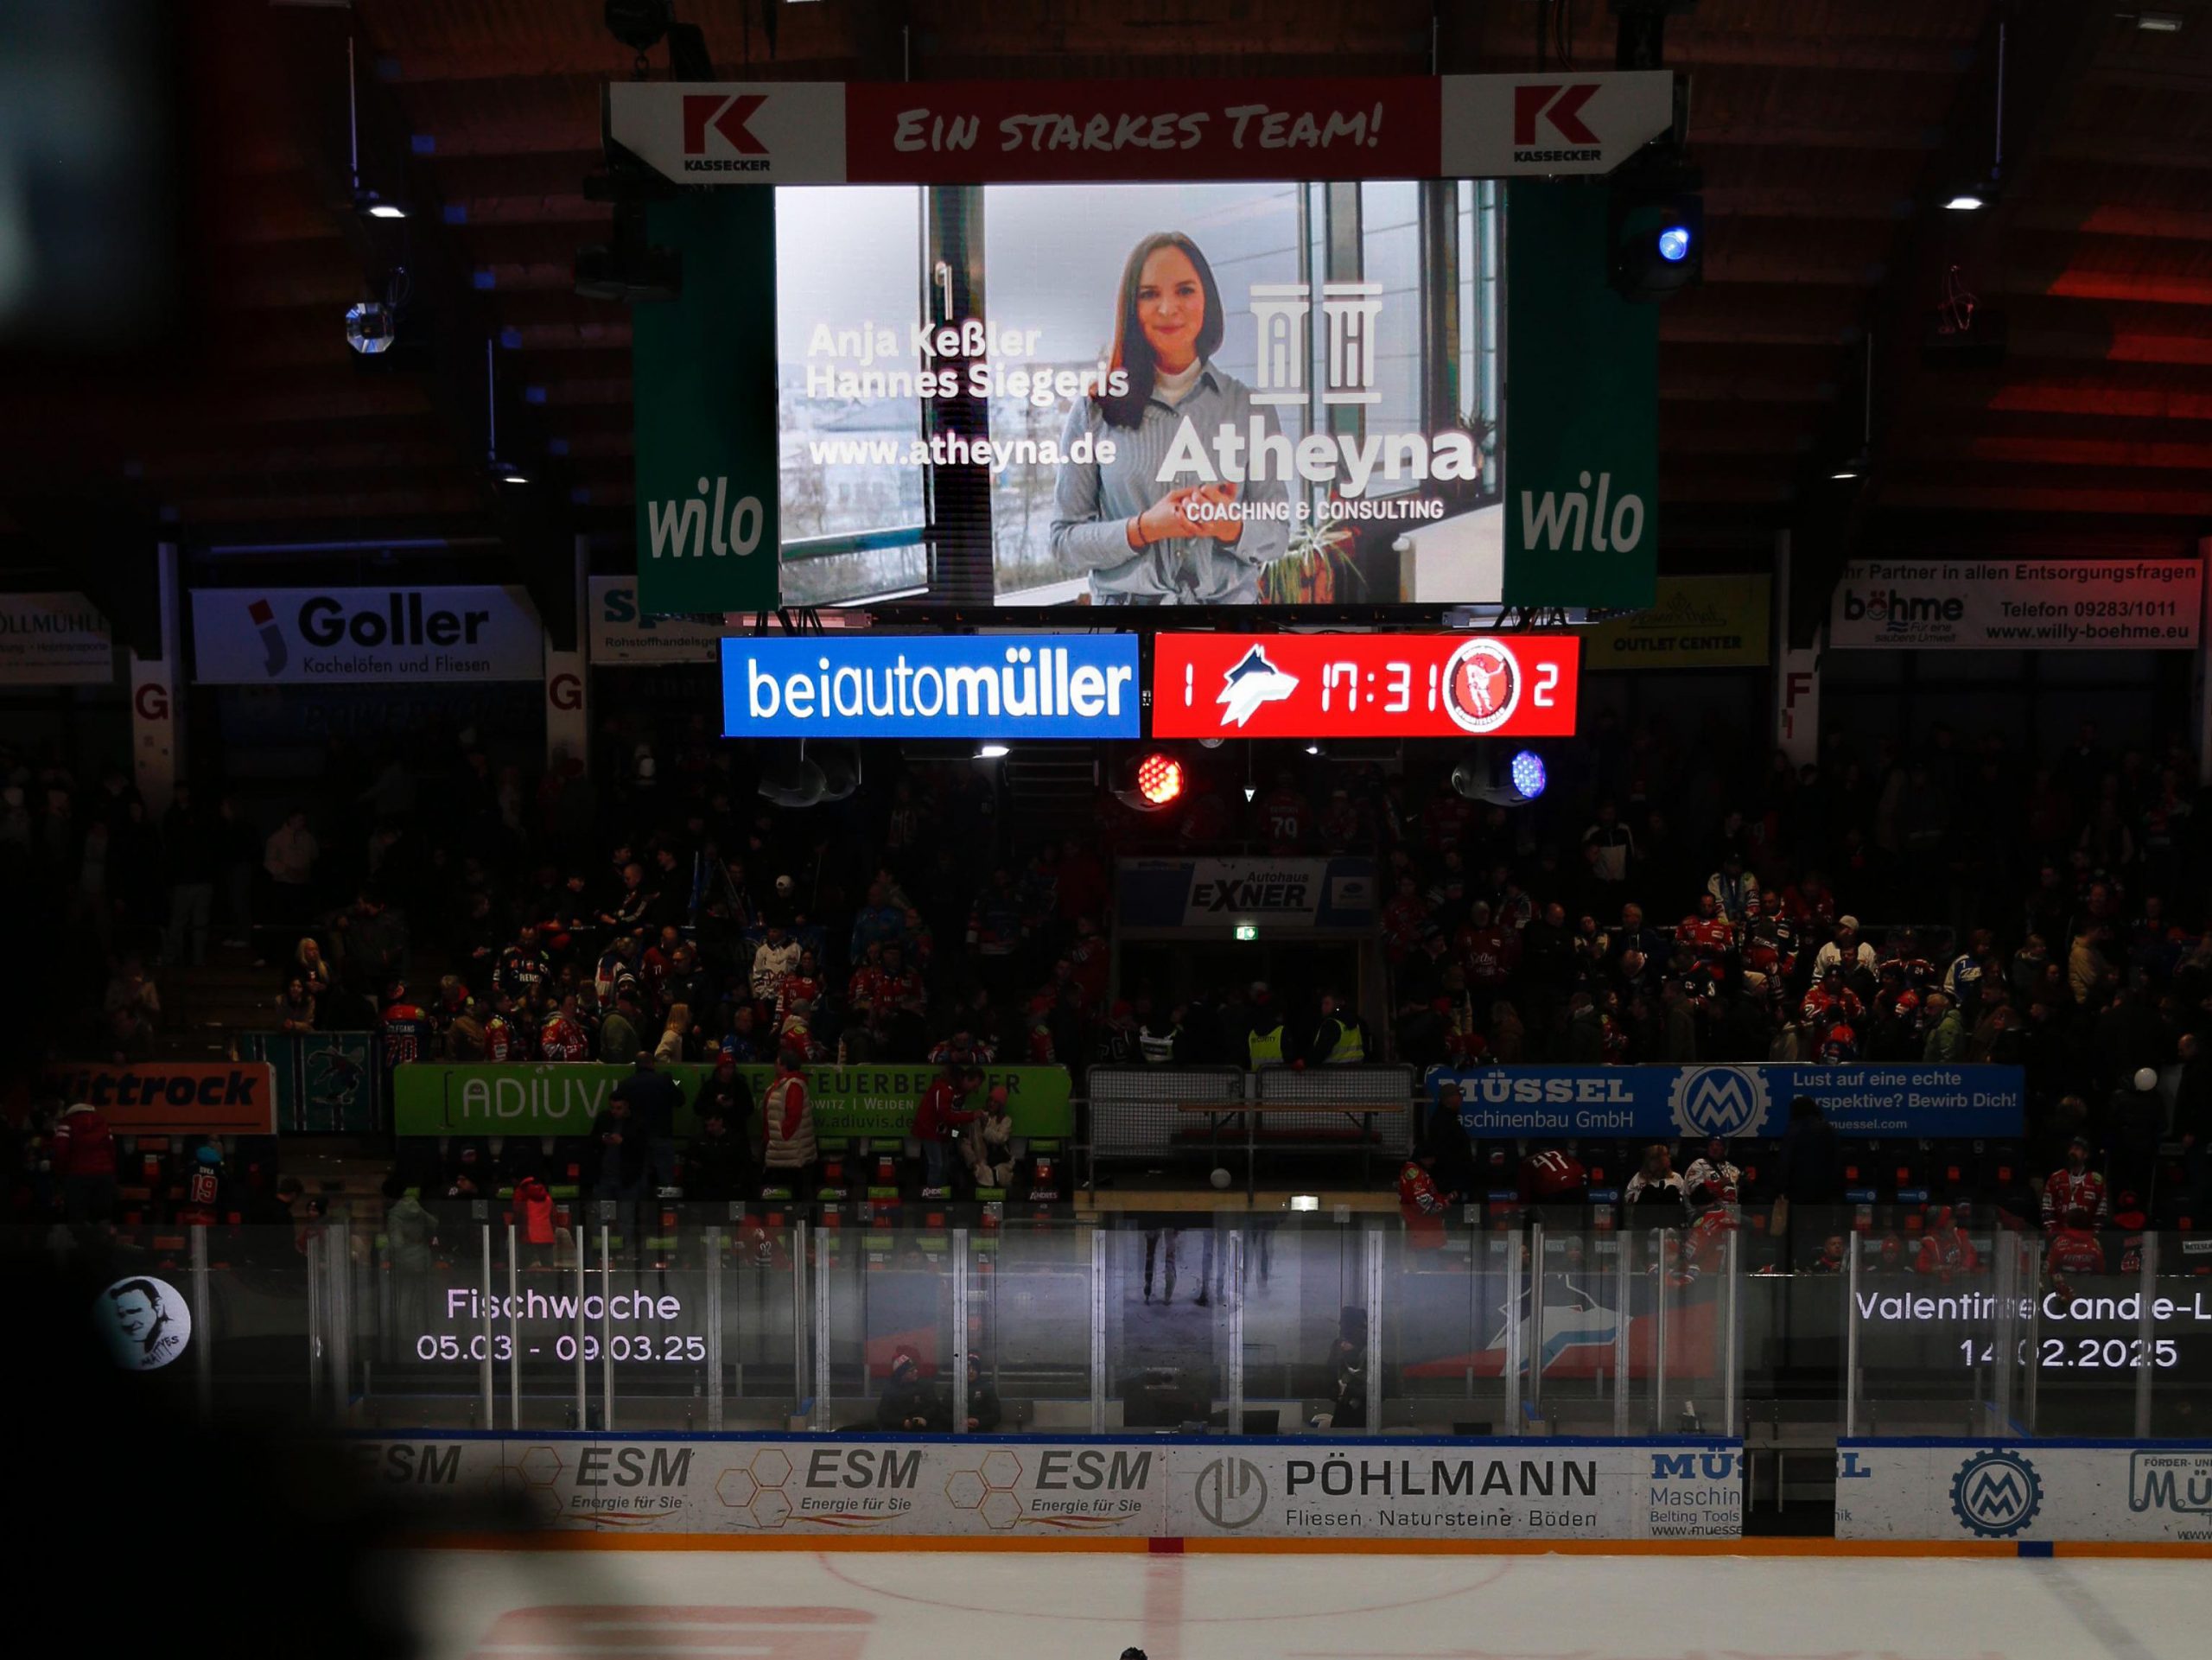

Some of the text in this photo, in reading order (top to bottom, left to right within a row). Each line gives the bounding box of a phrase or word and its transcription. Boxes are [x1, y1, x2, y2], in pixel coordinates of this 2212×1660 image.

[683, 160, 770, 171] KASSECKER
[1515, 150, 1601, 162] KASSECKER
[808, 319, 1042, 366] Anja Keßler
[807, 362, 1129, 406] Hannes Siegeris
[810, 431, 1116, 473] www.atheyna.de
[1156, 415, 1477, 499] Atheyna
[648, 476, 764, 558] wilo
[1186, 500, 1445, 521] COACHING & CONSULTING
[1521, 471, 1644, 553] wilo
[1870, 565, 1936, 580] Partner
[1942, 564, 1958, 580] in
[1966, 564, 2008, 580] allen
[2015, 564, 2196, 583] Entsorgungsfragen
[1844, 588, 1963, 620] böhme
[2001, 601, 2176, 617] Telefon 09283/1011
[299, 593, 489, 646] Goller
[1986, 623, 2190, 642] www.willy-boehme.eu
[1614, 636, 1741, 652] OUTLET CENTER
[304, 655, 490, 674] Kachelöfen und Fliesen
[135, 683, 168, 720] G
[550, 673, 582, 710] G
[1322, 662, 1436, 712] 17:31
[1534, 664, 1558, 708] 2
[1270, 816, 1298, 838] 70
[1247, 871, 1309, 884] Autohaus
[1793, 1071, 1961, 1086] Lust auf eine echte
[462, 1078, 620, 1118] ADIUV
[1793, 1092, 2017, 1110] rspektive? Bewirb Dich!
[1458, 1110, 1633, 1128] aschinenbau GmbH
[191, 1173, 219, 1204] 19
[448, 1288, 681, 1320] Fischwoche
[416, 1334, 513, 1362] 05.03
[556, 1334, 707, 1362] 09.03.25
[575, 1447, 692, 1487] ESM
[805, 1448, 922, 1489] ESM
[1035, 1450, 1152, 1491] ESM
[1287, 1453, 1597, 1497] PÖHLMANN
[1651, 1443, 1744, 1479] MÜ
[571, 1495, 682, 1511] Energie für Sie
[801, 1497, 912, 1513] Energie für Sie
[1032, 1498, 1141, 1515] Energie für Sie
[1287, 1508, 1597, 1527] Fliesen Natursteine Böden
[1650, 1510, 1739, 1523] Belting Tools
